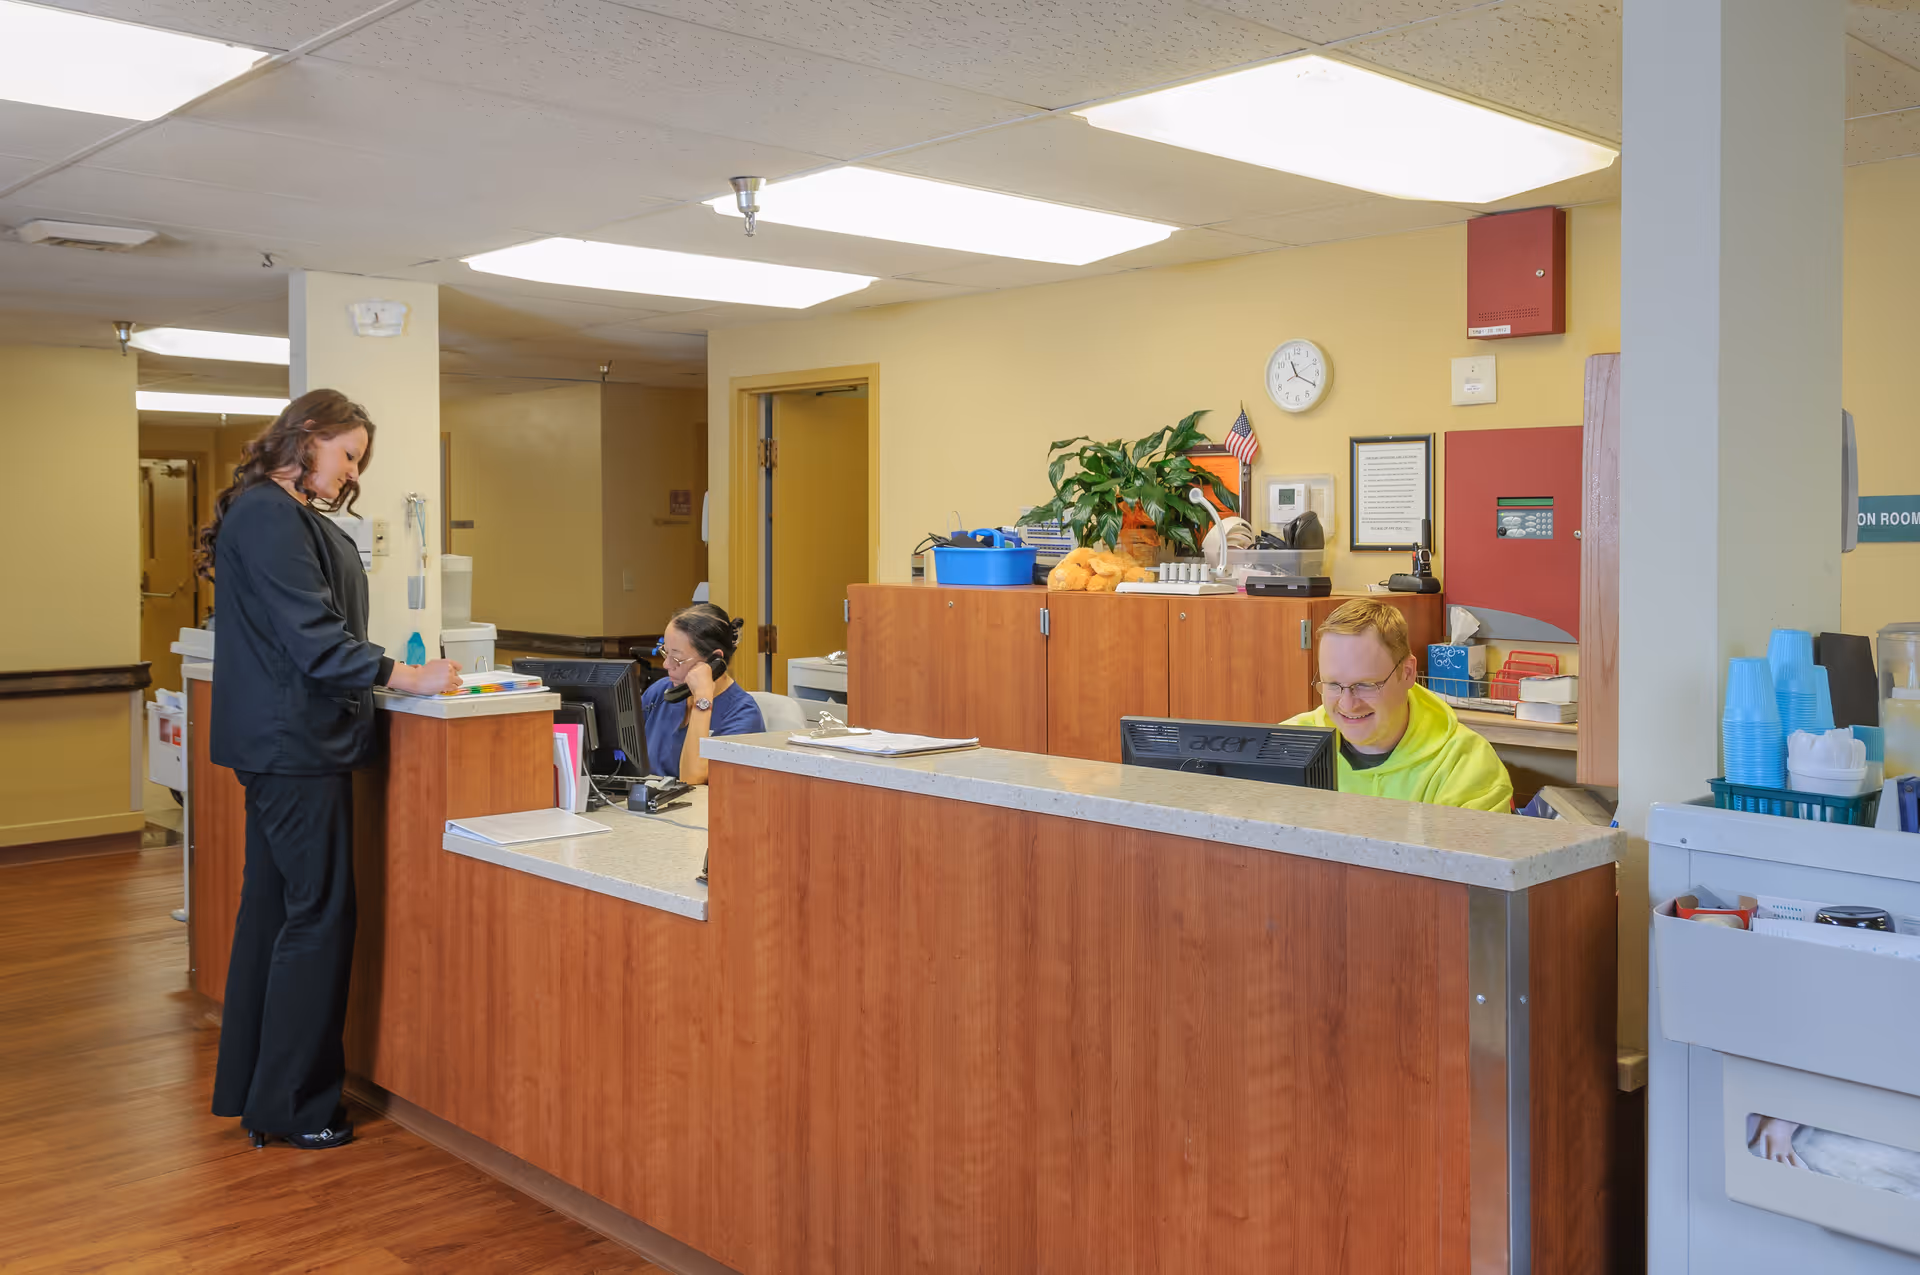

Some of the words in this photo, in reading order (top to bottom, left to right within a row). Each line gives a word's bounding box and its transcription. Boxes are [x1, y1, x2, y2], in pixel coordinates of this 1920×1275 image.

[1293, 347, 1301, 356] 12
[1277, 360, 1285, 369] 10
[1312, 358, 1317, 366] 2
[1314, 369, 1320, 377] 3
[1277, 383, 1283, 392] 8
[1285, 391, 1290, 400] 7
[1295, 394, 1301, 402] 6
[1304, 390, 1310, 398] 5
[1880, 511, 1920, 526] ROOM
[1189, 735, 1257, 753] acer
